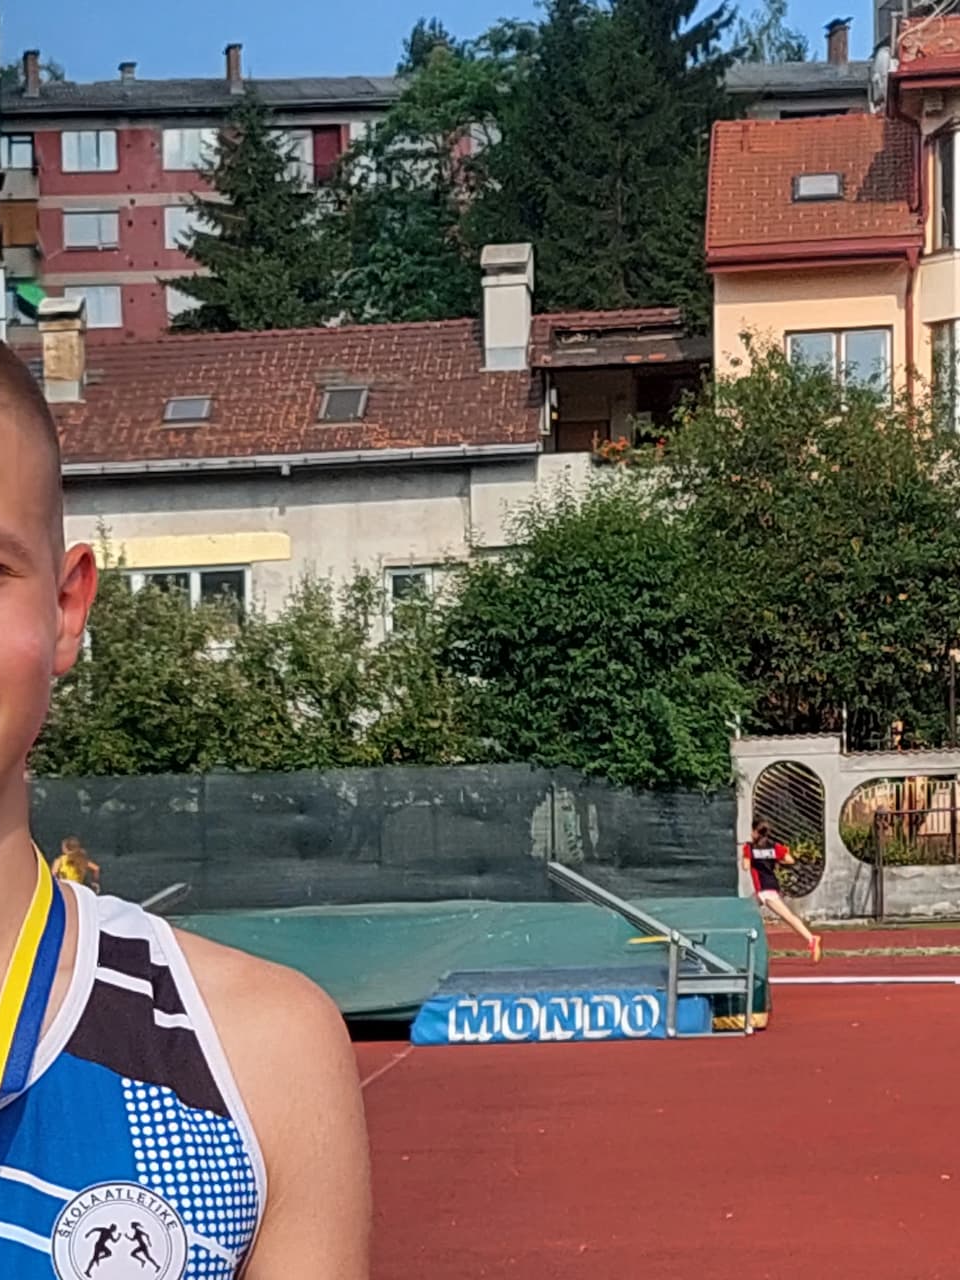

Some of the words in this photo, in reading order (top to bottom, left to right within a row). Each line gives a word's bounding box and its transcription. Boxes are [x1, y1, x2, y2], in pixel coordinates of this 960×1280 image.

[448, 995, 660, 1041] MONDO
[57, 1194, 100, 1239] ŠKOLA
[104, 1188, 179, 1231] ATLETIKE
